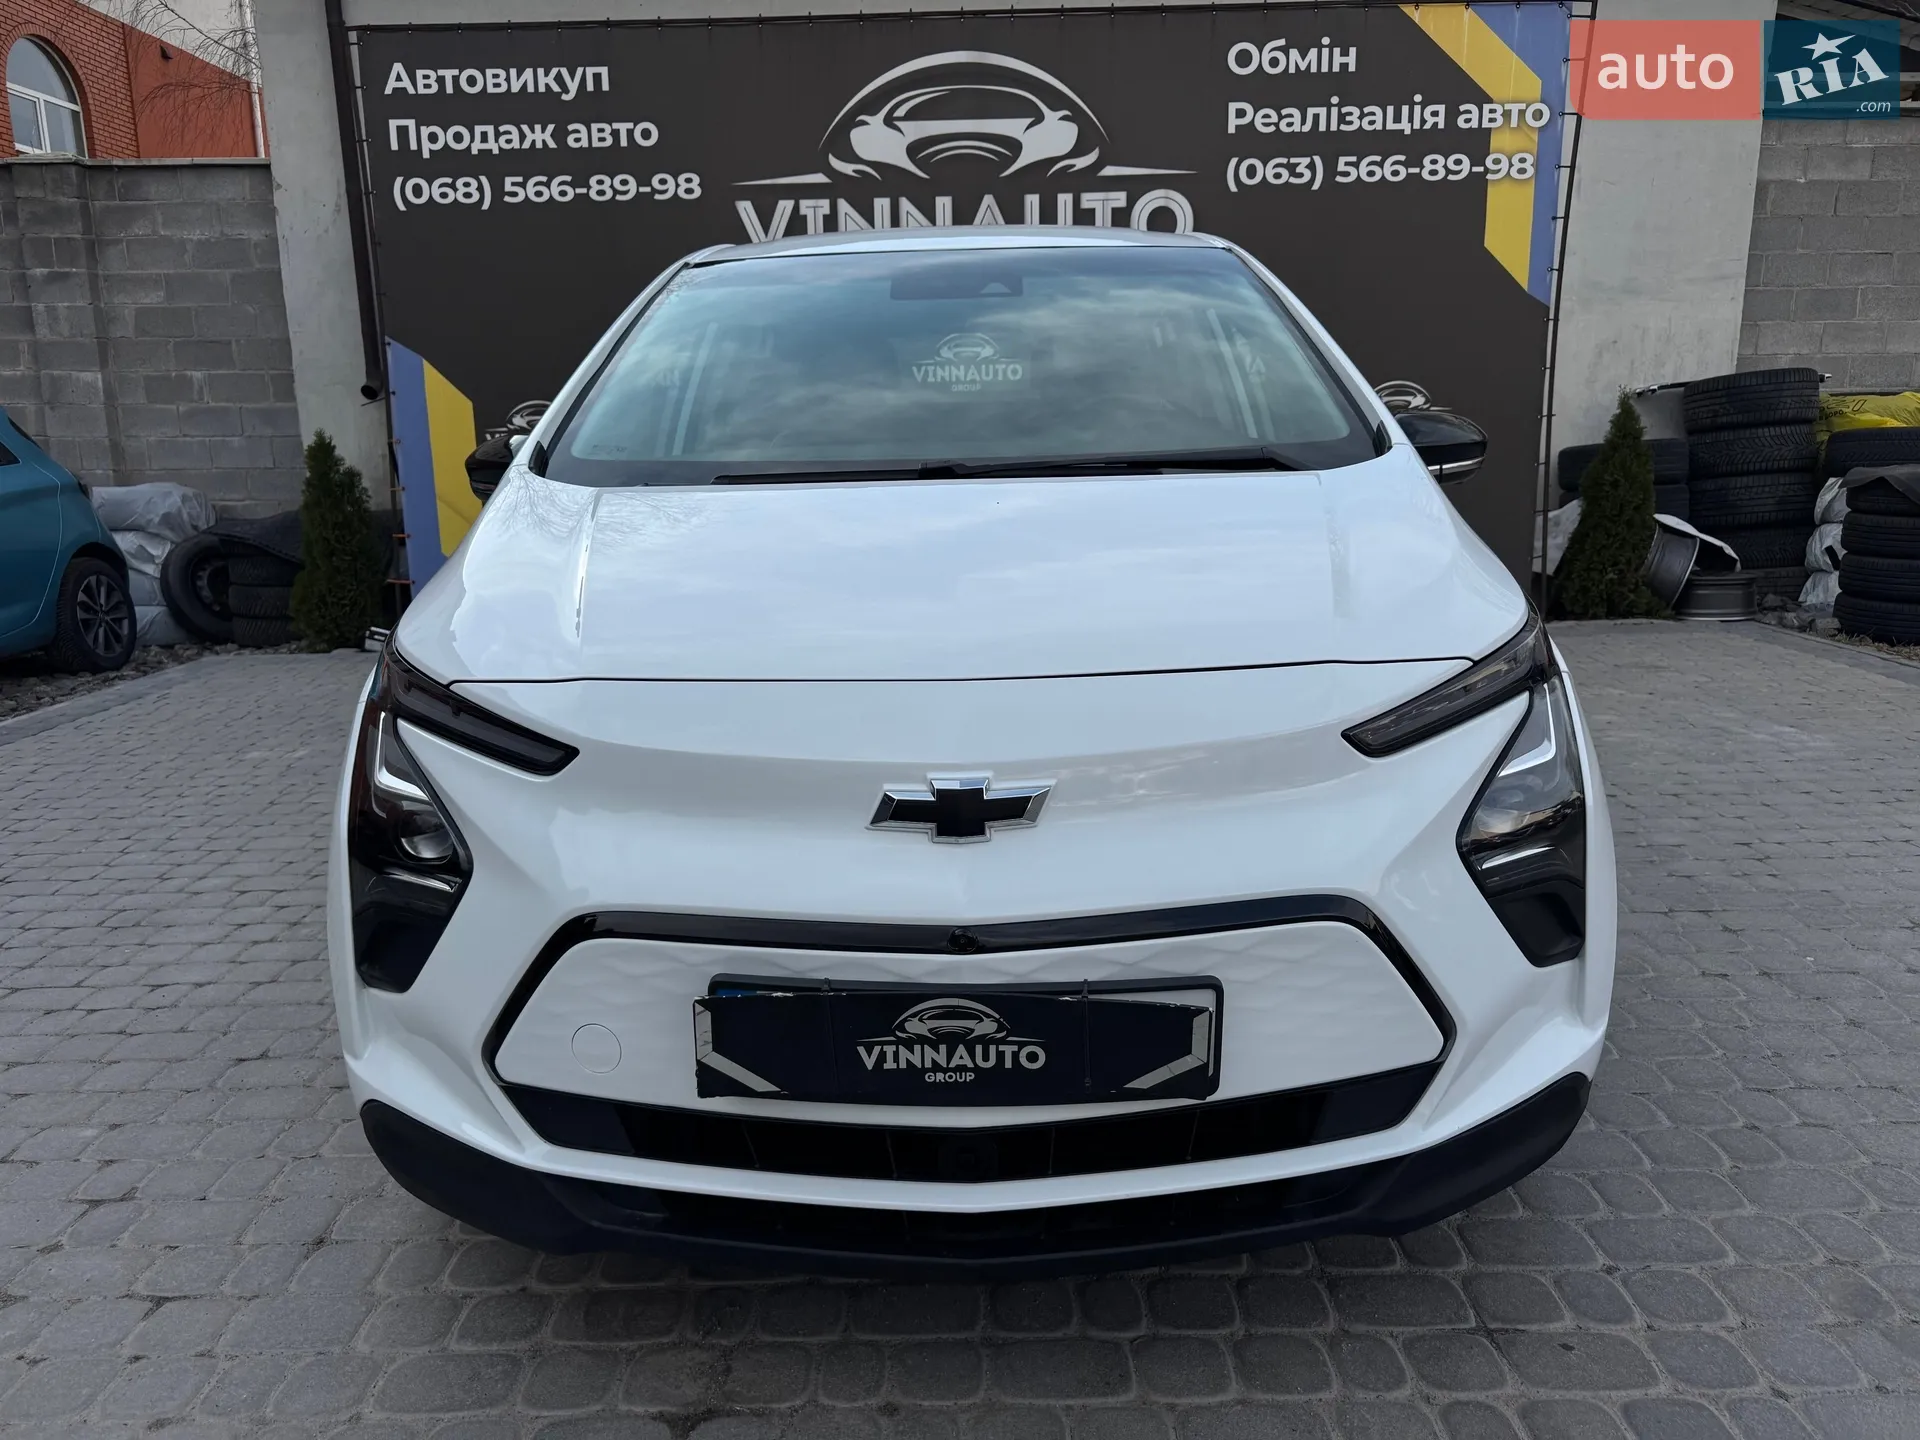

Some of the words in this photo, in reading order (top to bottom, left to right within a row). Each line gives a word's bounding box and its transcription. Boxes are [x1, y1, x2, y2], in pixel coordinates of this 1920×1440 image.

[1227, 36, 1357, 76] Обмін
[384, 62, 610, 101] Автовикуп
[1227, 93, 1446, 135] Реалізація
[1456, 101, 1551, 130] авто
[388, 118, 558, 159] Продаж
[566, 121, 660, 149] авто
[393, 175, 492, 211] (068)
[503, 172, 702, 203] 566-89-98
[1226, 155, 1324, 192] (063)
[1335, 153, 1535, 183] 566-89-98
[912, 364, 1023, 383] VINNAUTO
[856, 1044, 1046, 1071] VINNAUTO
[924, 1071, 975, 1083] GROUP
